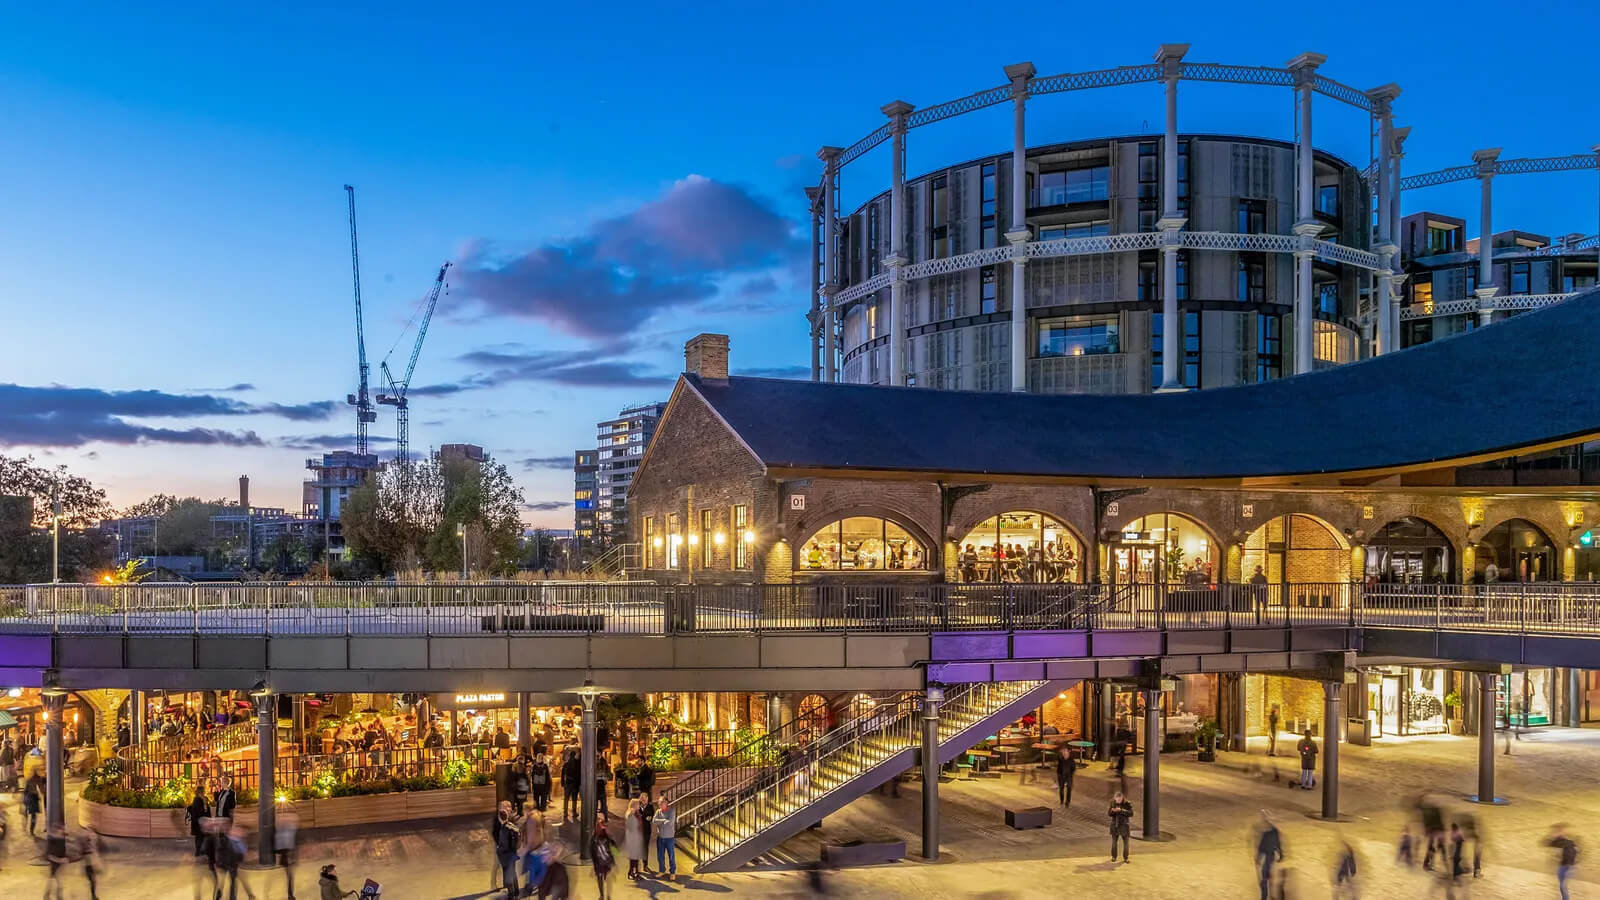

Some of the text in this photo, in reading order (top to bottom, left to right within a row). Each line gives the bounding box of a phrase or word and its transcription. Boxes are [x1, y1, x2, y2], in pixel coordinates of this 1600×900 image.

[793, 498, 804, 507] 01
[1108, 505, 1118, 513] 03
[1243, 507, 1252, 515] 04
[456, 694, 478, 704] PLAZA
